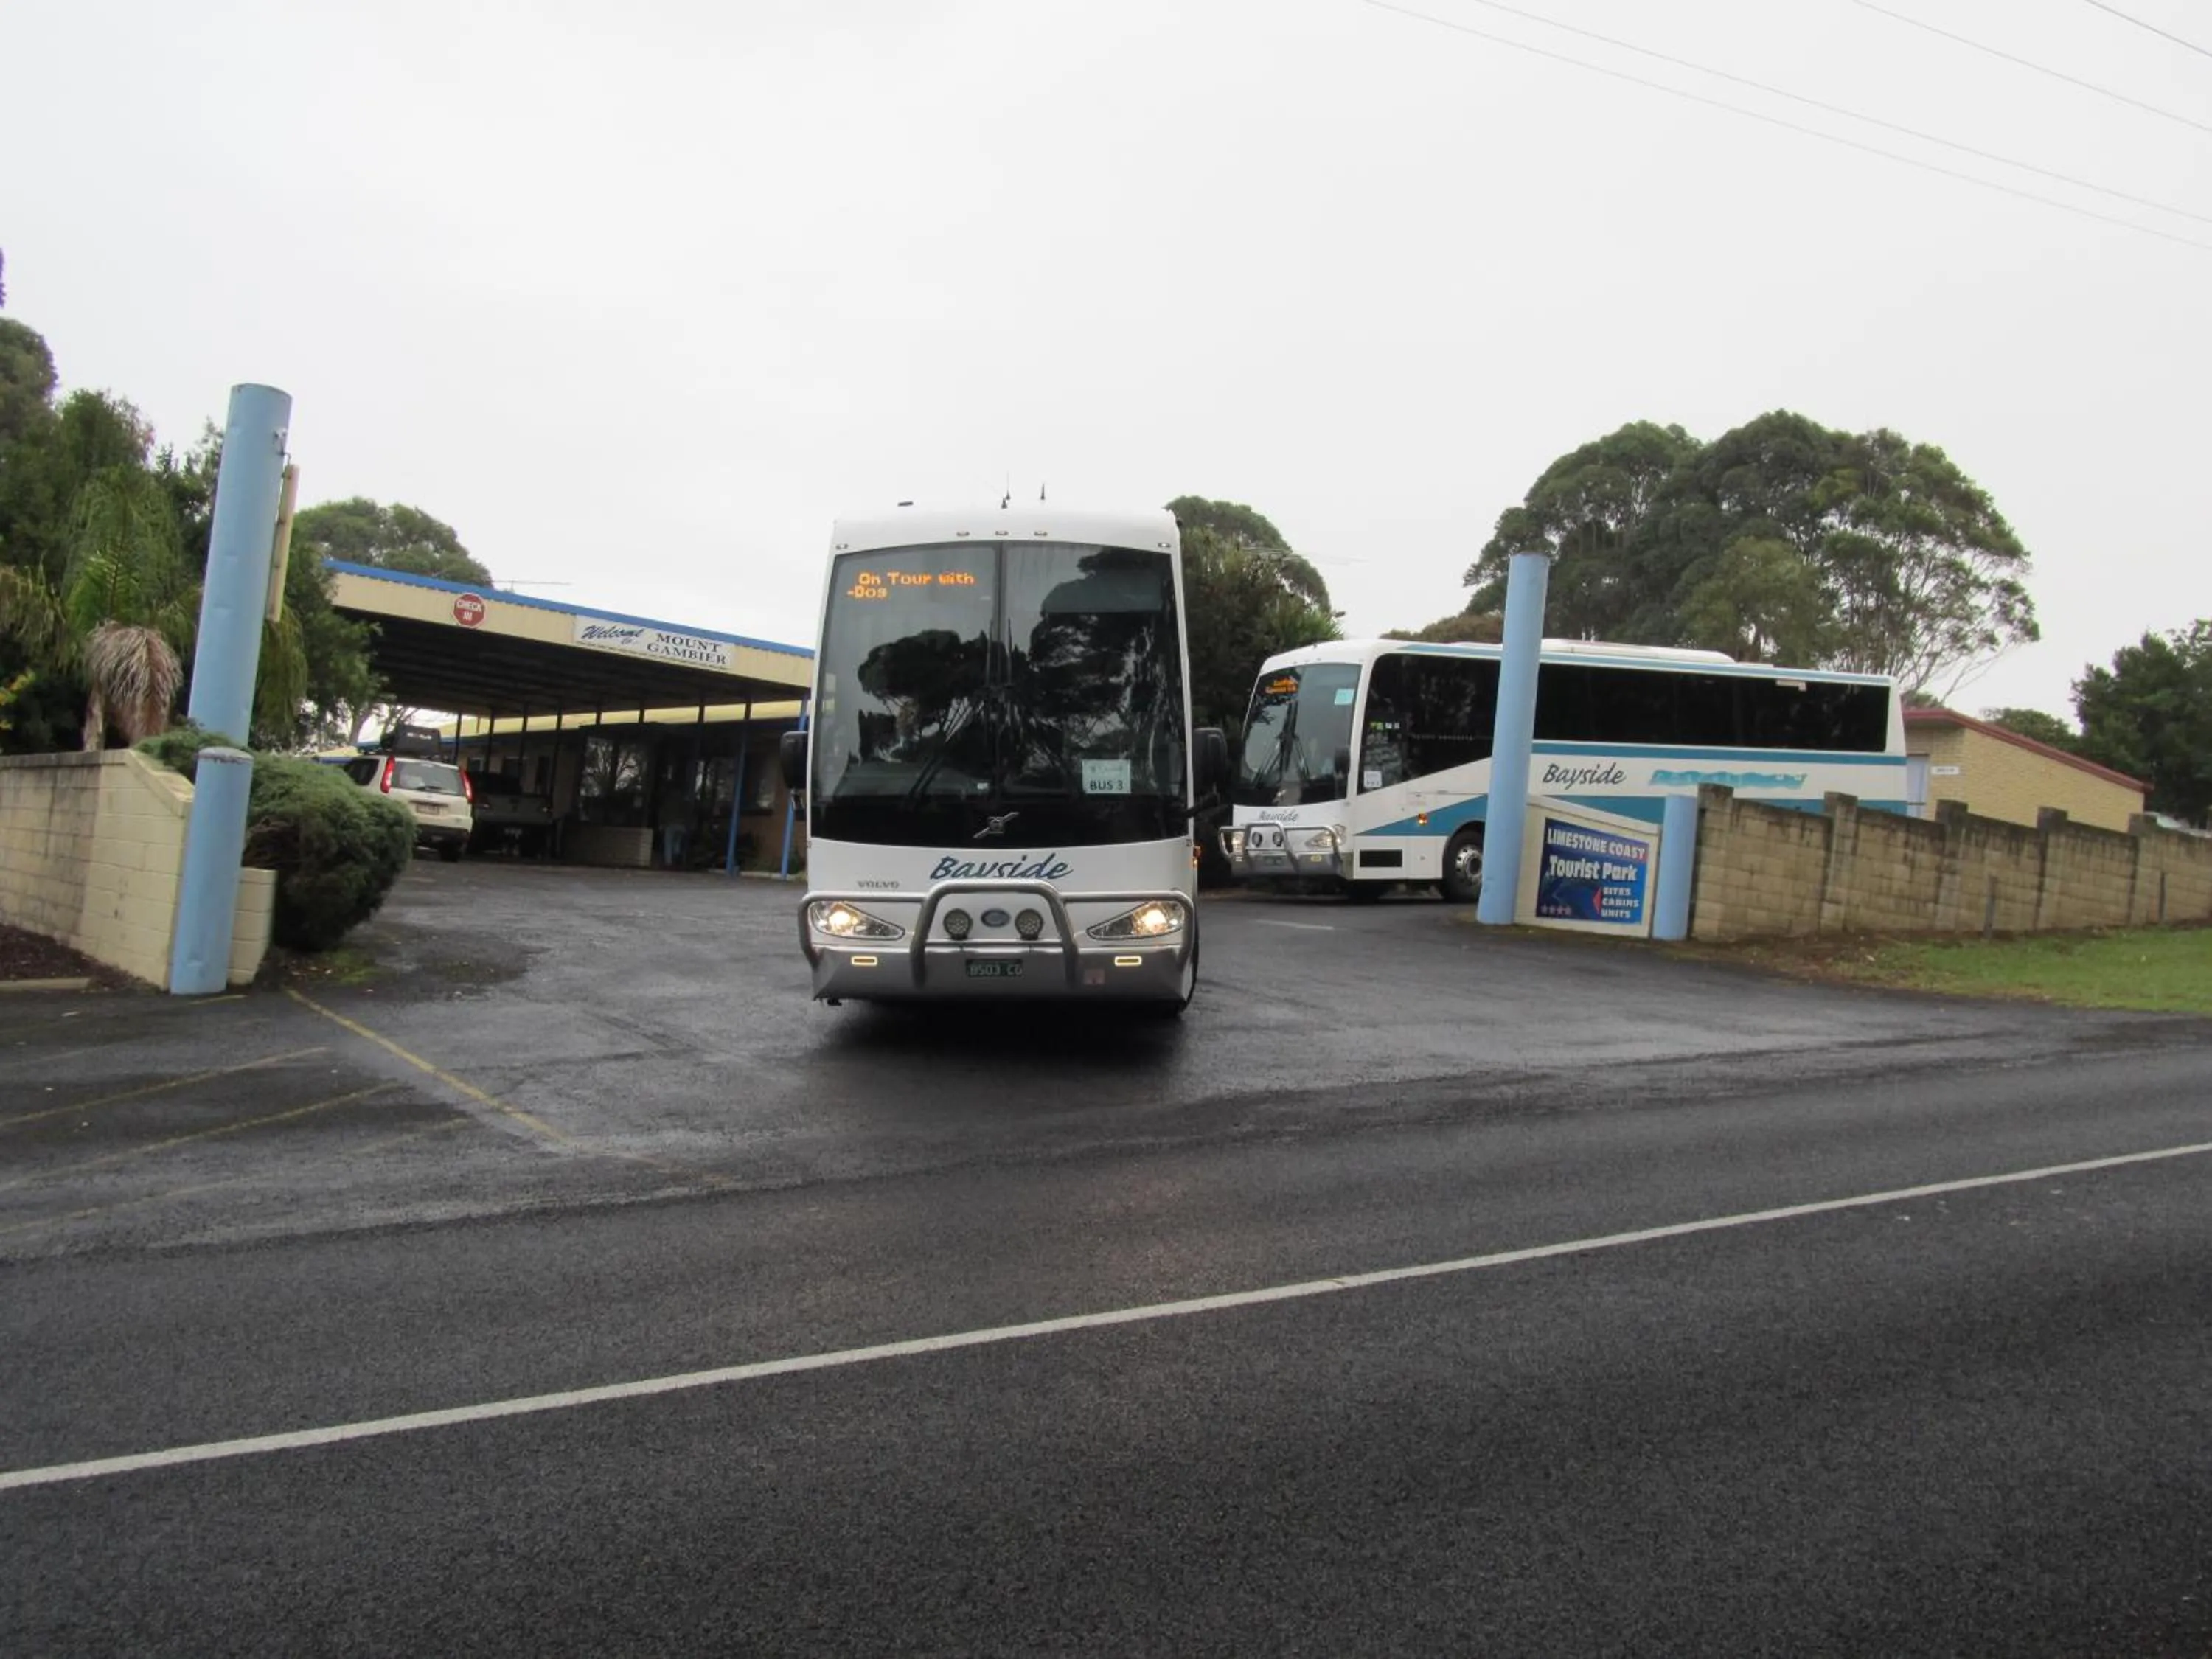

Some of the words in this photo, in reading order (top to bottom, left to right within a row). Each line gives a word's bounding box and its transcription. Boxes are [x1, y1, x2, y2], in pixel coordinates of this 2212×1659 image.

[858, 572, 881, 585] On
[887, 571, 932, 585] Tour
[938, 572, 975, 585] with
[647, 642, 727, 664] GAMBIER
[655, 633, 722, 653] MOUNT
[1090, 779, 1113, 791] BUS
[1542, 761, 1627, 791] Bayside
[1547, 827, 1607, 853] LIMESTONE
[1608, 840, 1646, 860] COAST
[930, 852, 1074, 880] Bayside
[1549, 855, 1600, 880] Tourist
[1602, 861, 1638, 881] Park
[858, 880, 900, 889] VOLVO
[1602, 897, 1640, 908] CABINS
[1601, 909, 1632, 919] UNITS
